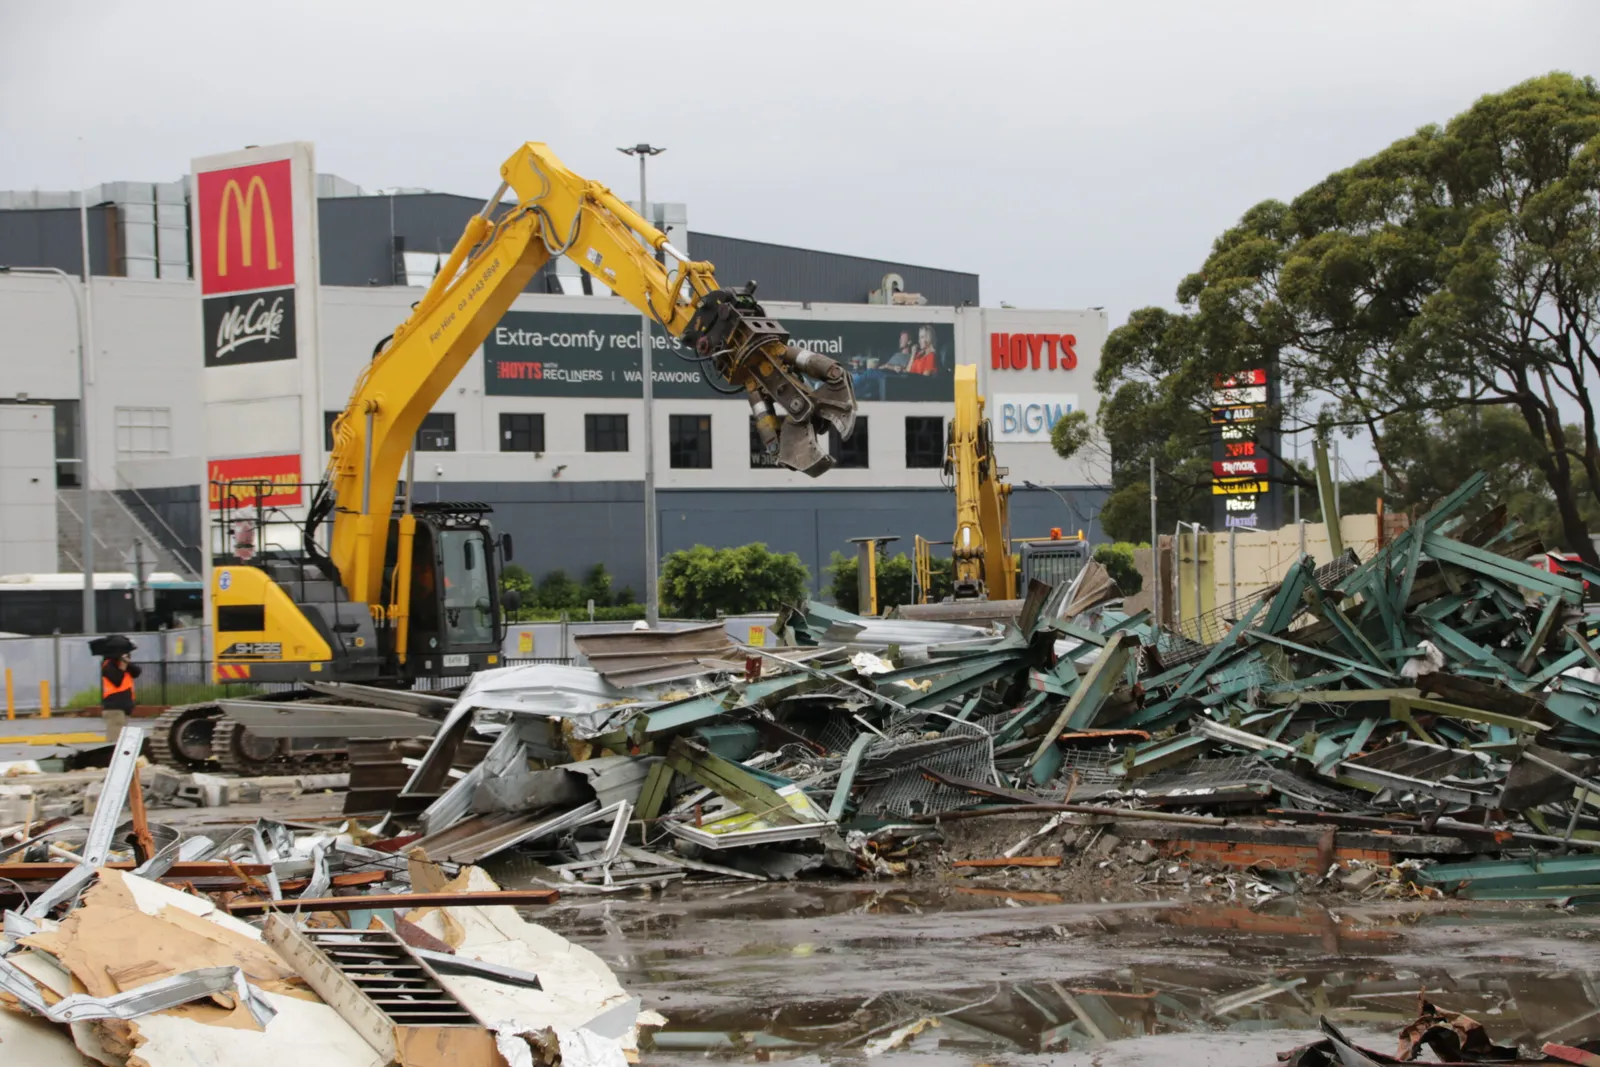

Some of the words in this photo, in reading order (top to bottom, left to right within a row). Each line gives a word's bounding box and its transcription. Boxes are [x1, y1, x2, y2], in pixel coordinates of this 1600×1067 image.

[495, 327, 605, 351] Extra-comfy
[610, 330, 681, 350] reclners
[990, 333, 1078, 370] HOYTS
[499, 361, 542, 379] HOYTS
[543, 369, 603, 382] RECLINERS
[624, 371, 700, 383] WARAWONG
[1233, 408, 1254, 419] ALDI
